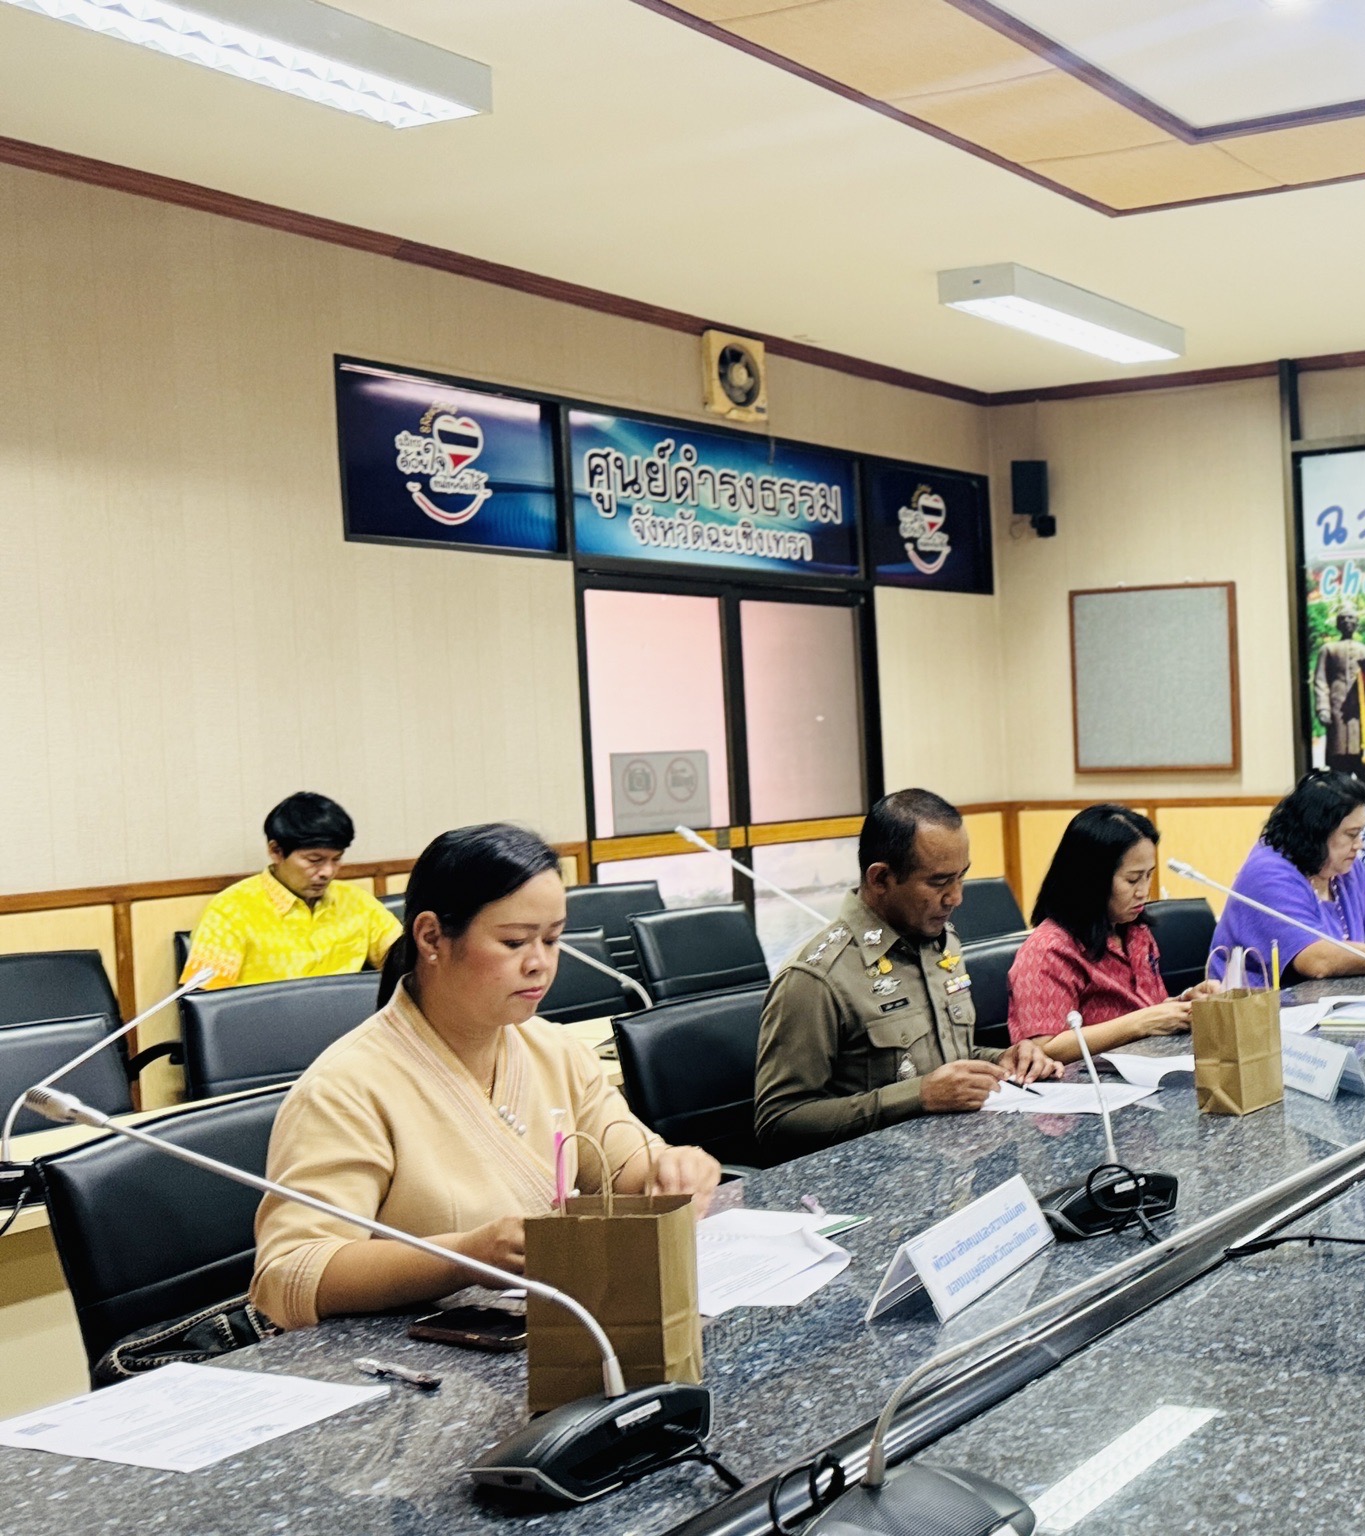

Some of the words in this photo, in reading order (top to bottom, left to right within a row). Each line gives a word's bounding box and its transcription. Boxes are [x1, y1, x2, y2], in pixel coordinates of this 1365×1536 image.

[585, 439, 843, 523] ศูนย์ดำรงธรรม
[630, 503, 813, 561] จังหวัดฉะเชิงเทรา
